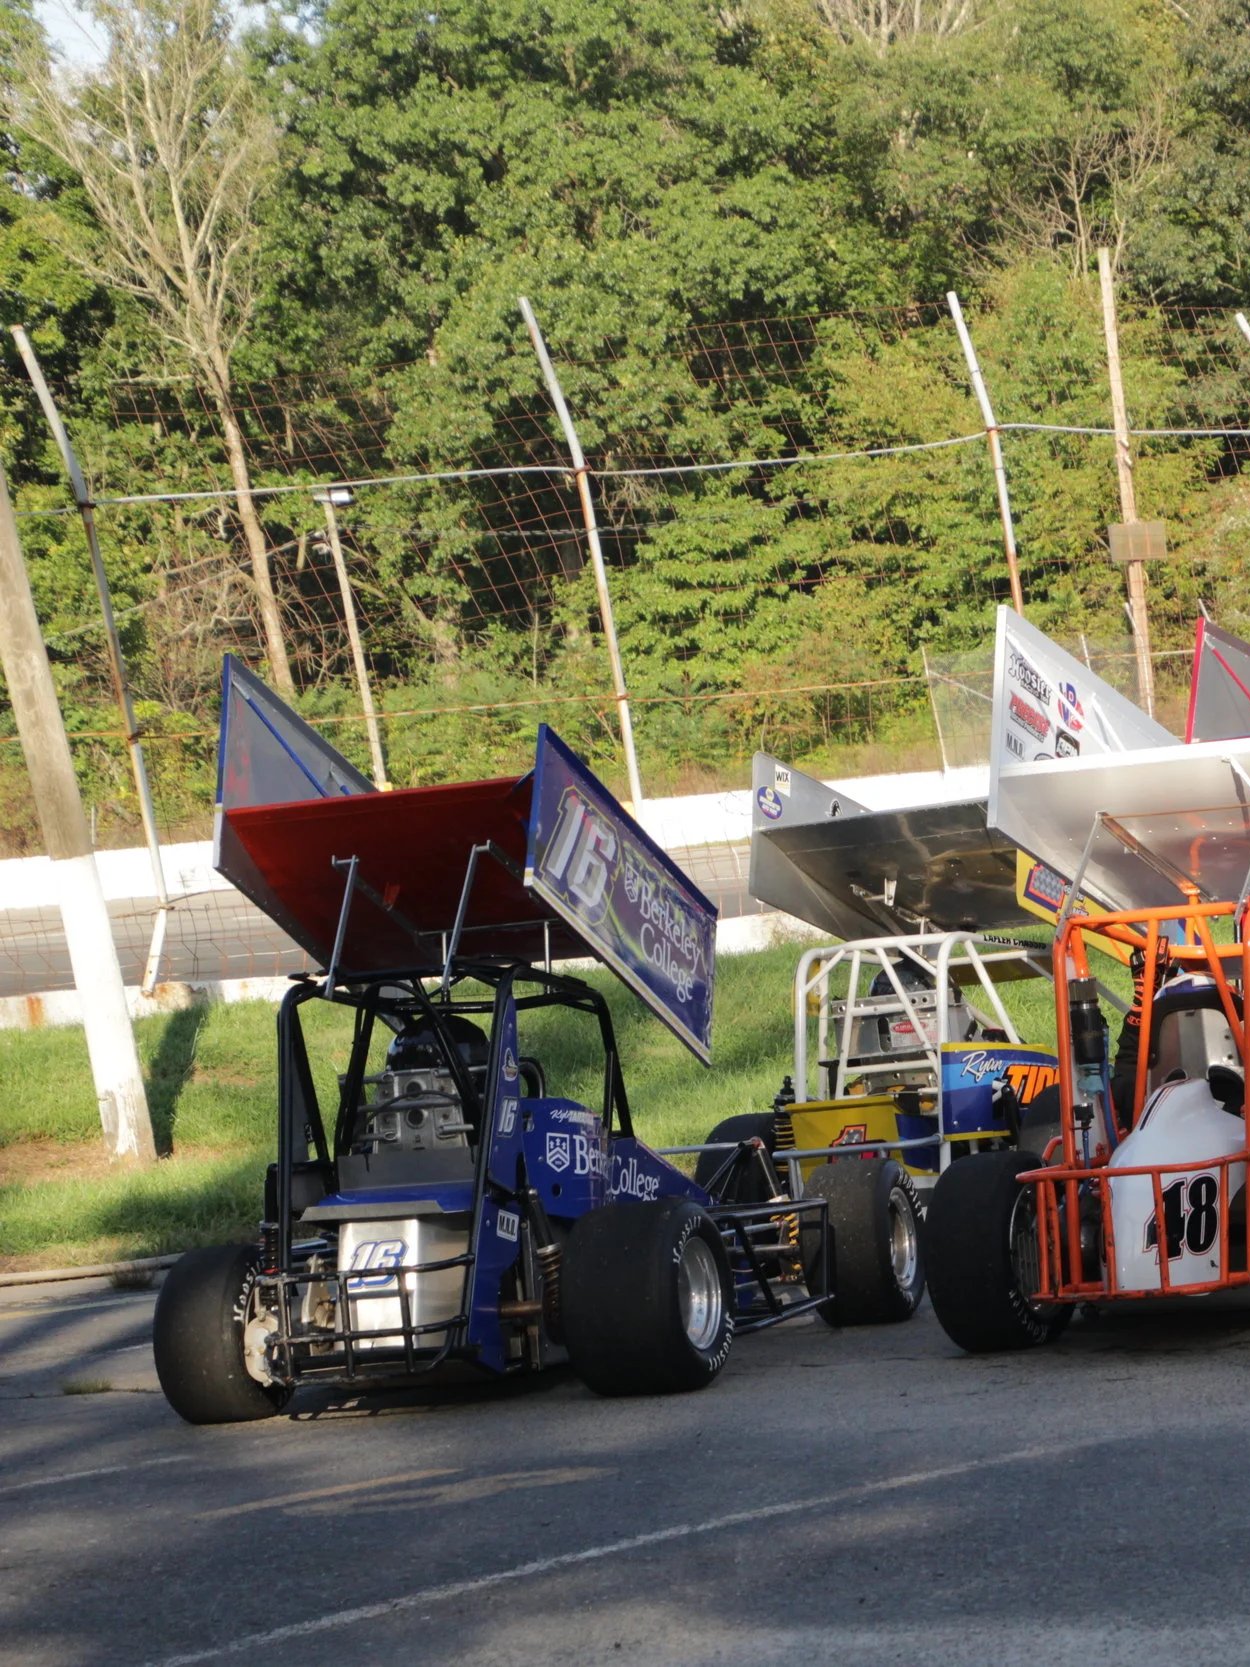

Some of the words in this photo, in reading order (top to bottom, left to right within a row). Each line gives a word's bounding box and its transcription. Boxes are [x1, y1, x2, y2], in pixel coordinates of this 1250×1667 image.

[775, 771, 790, 783] WIX
[546, 796, 617, 909] 16
[640, 879, 701, 974] Berkeley
[640, 924, 694, 1003] College
[961, 1050, 1003, 1083] Ryan
[1006, 1064, 1060, 1104] TID
[497, 1099, 518, 1133] 16
[610, 1155, 660, 1201] College
[1143, 1174, 1219, 1263] 48
[348, 1239, 407, 1289] 16
